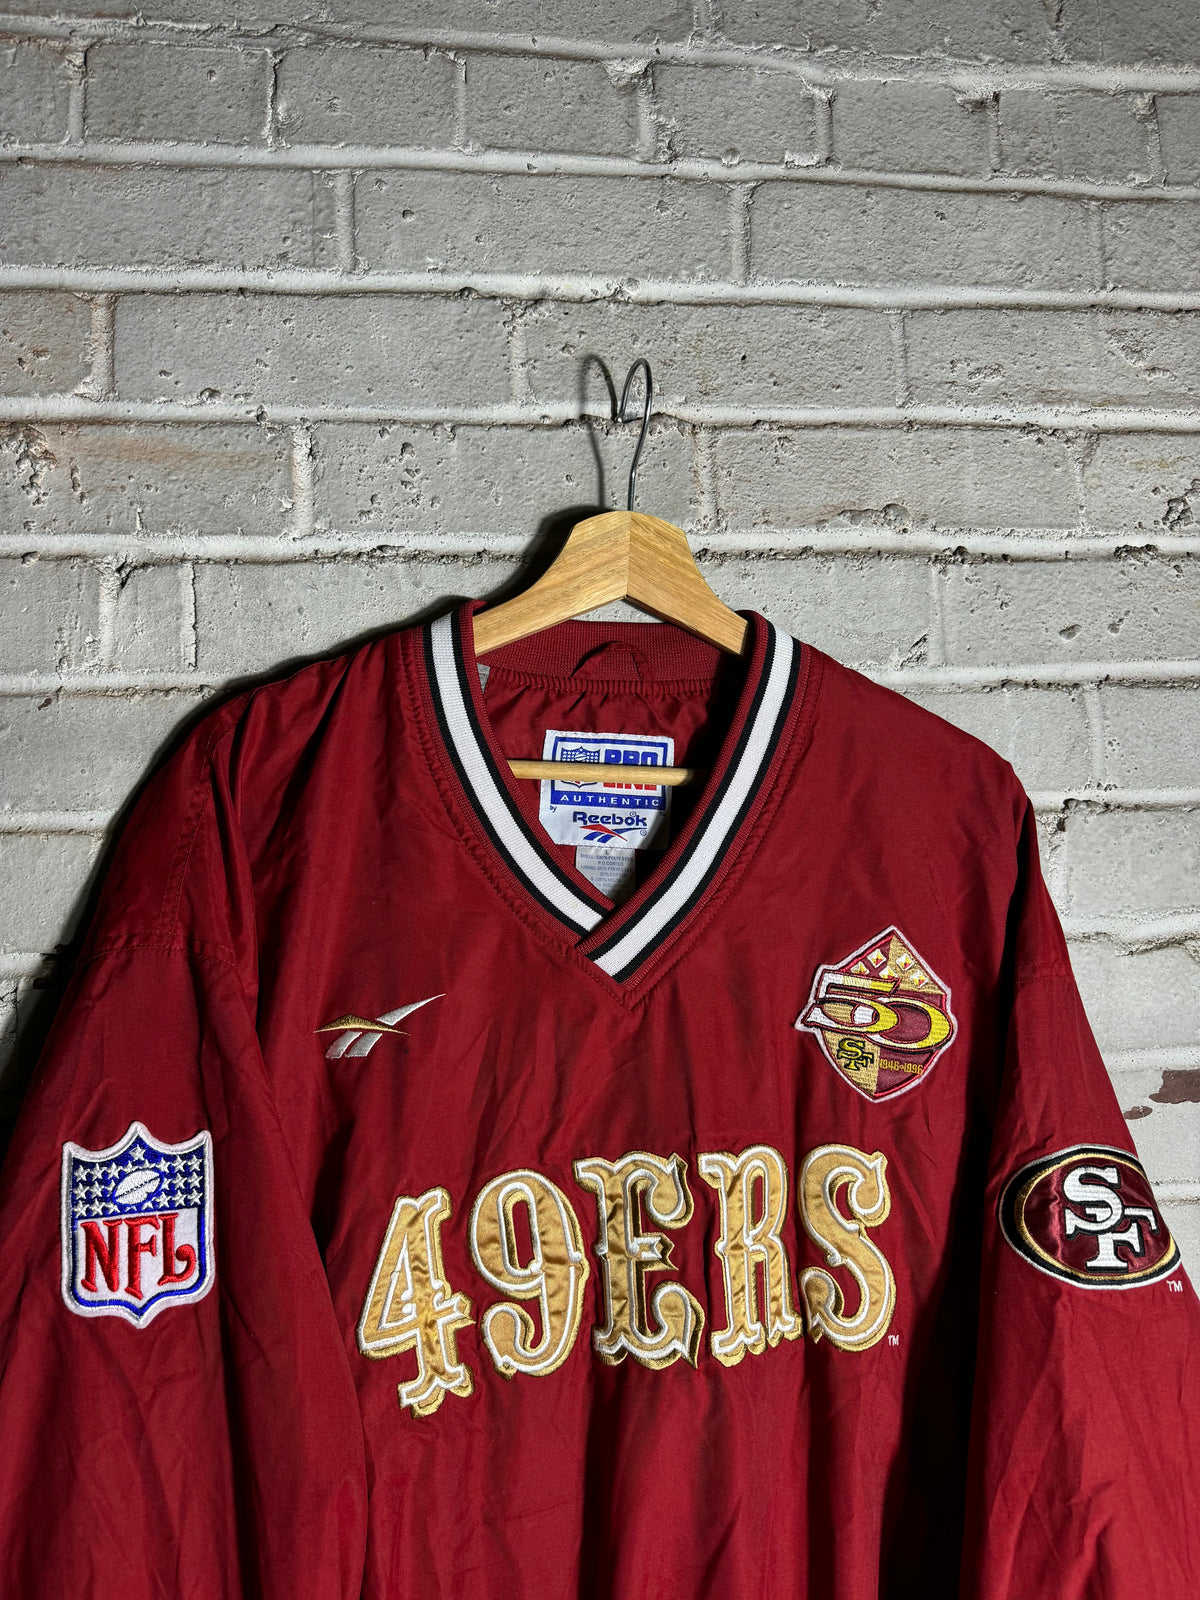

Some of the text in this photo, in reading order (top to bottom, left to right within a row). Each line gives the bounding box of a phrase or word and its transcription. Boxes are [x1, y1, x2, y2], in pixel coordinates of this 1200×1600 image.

[550, 805, 557, 813] by
[560, 794, 660, 807] AUTHENTIC
[572, 811, 648, 827] Reebok
[801, 969, 954, 1054] 50
[836, 1038, 875, 1071] SF
[1062, 1164, 1160, 1274] SF
[80, 1212, 197, 1300] NFL
[357, 1143, 897, 1419] 49ERS
[1166, 1280, 1184, 1293] TM
[887, 1334, 900, 1346] TM
